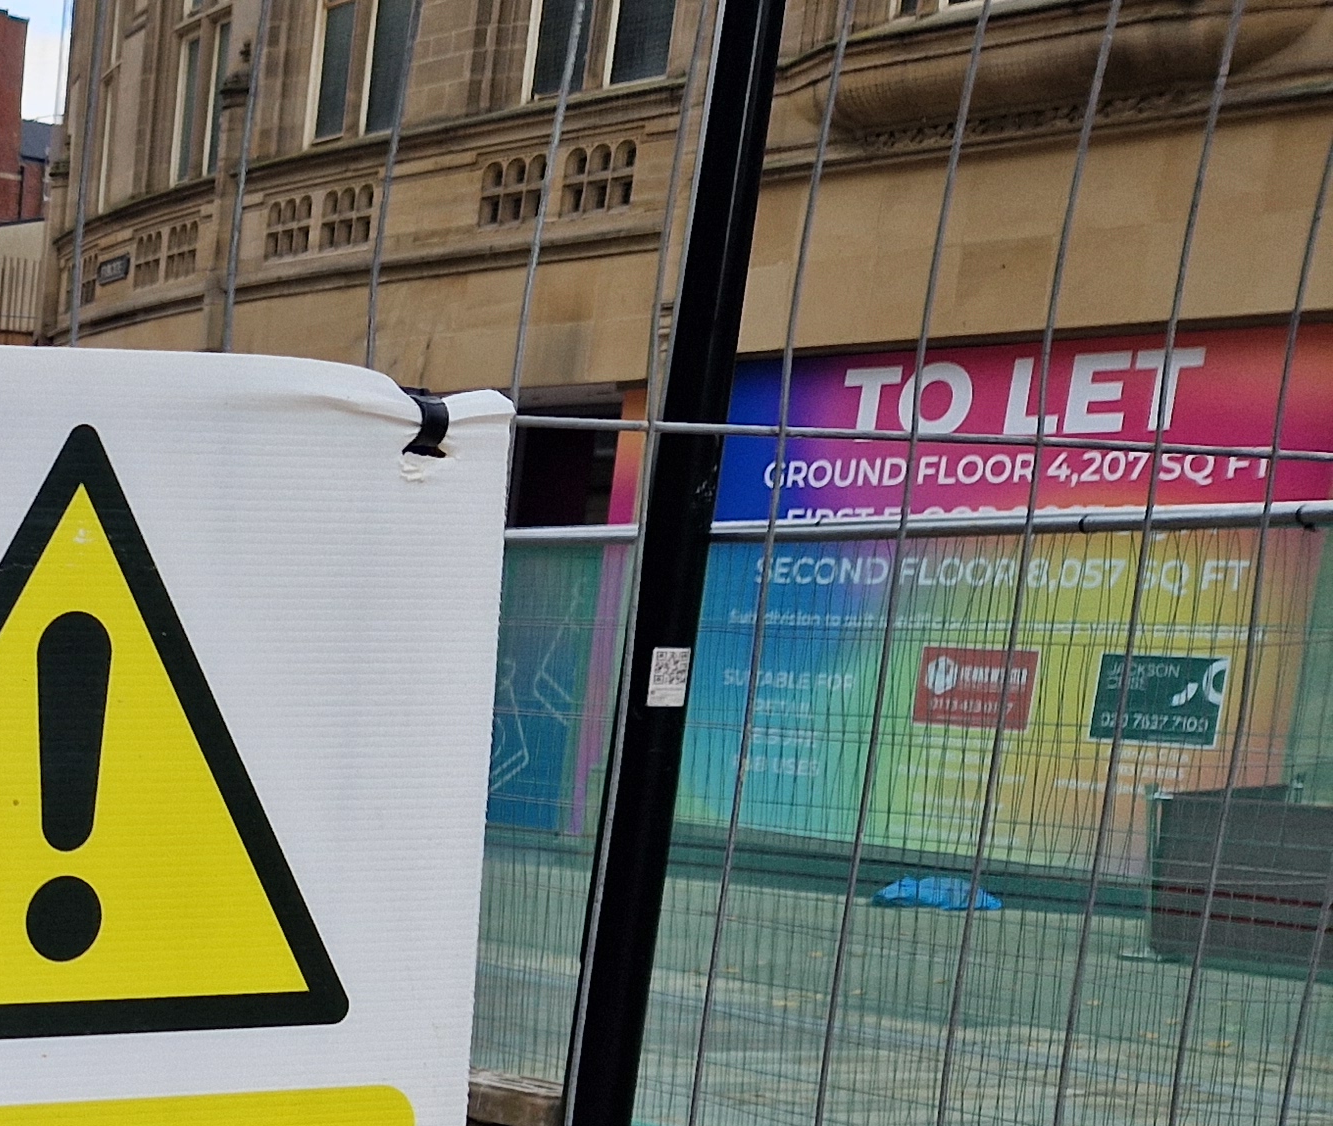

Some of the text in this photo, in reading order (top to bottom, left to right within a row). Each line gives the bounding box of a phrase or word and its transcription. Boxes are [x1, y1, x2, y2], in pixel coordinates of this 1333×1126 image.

[843, 345, 1207, 443] TO LET
[763, 457, 907, 490] GROUND
[917, 453, 1034, 486] FLOOR
[1047, 451, 1151, 488] 4,207
[1157, 453, 1215, 486] SQ
[756, 556, 890, 586] SECOND
[899, 557, 1015, 587] FLOOR
[1201, 559, 1253, 593] FT
